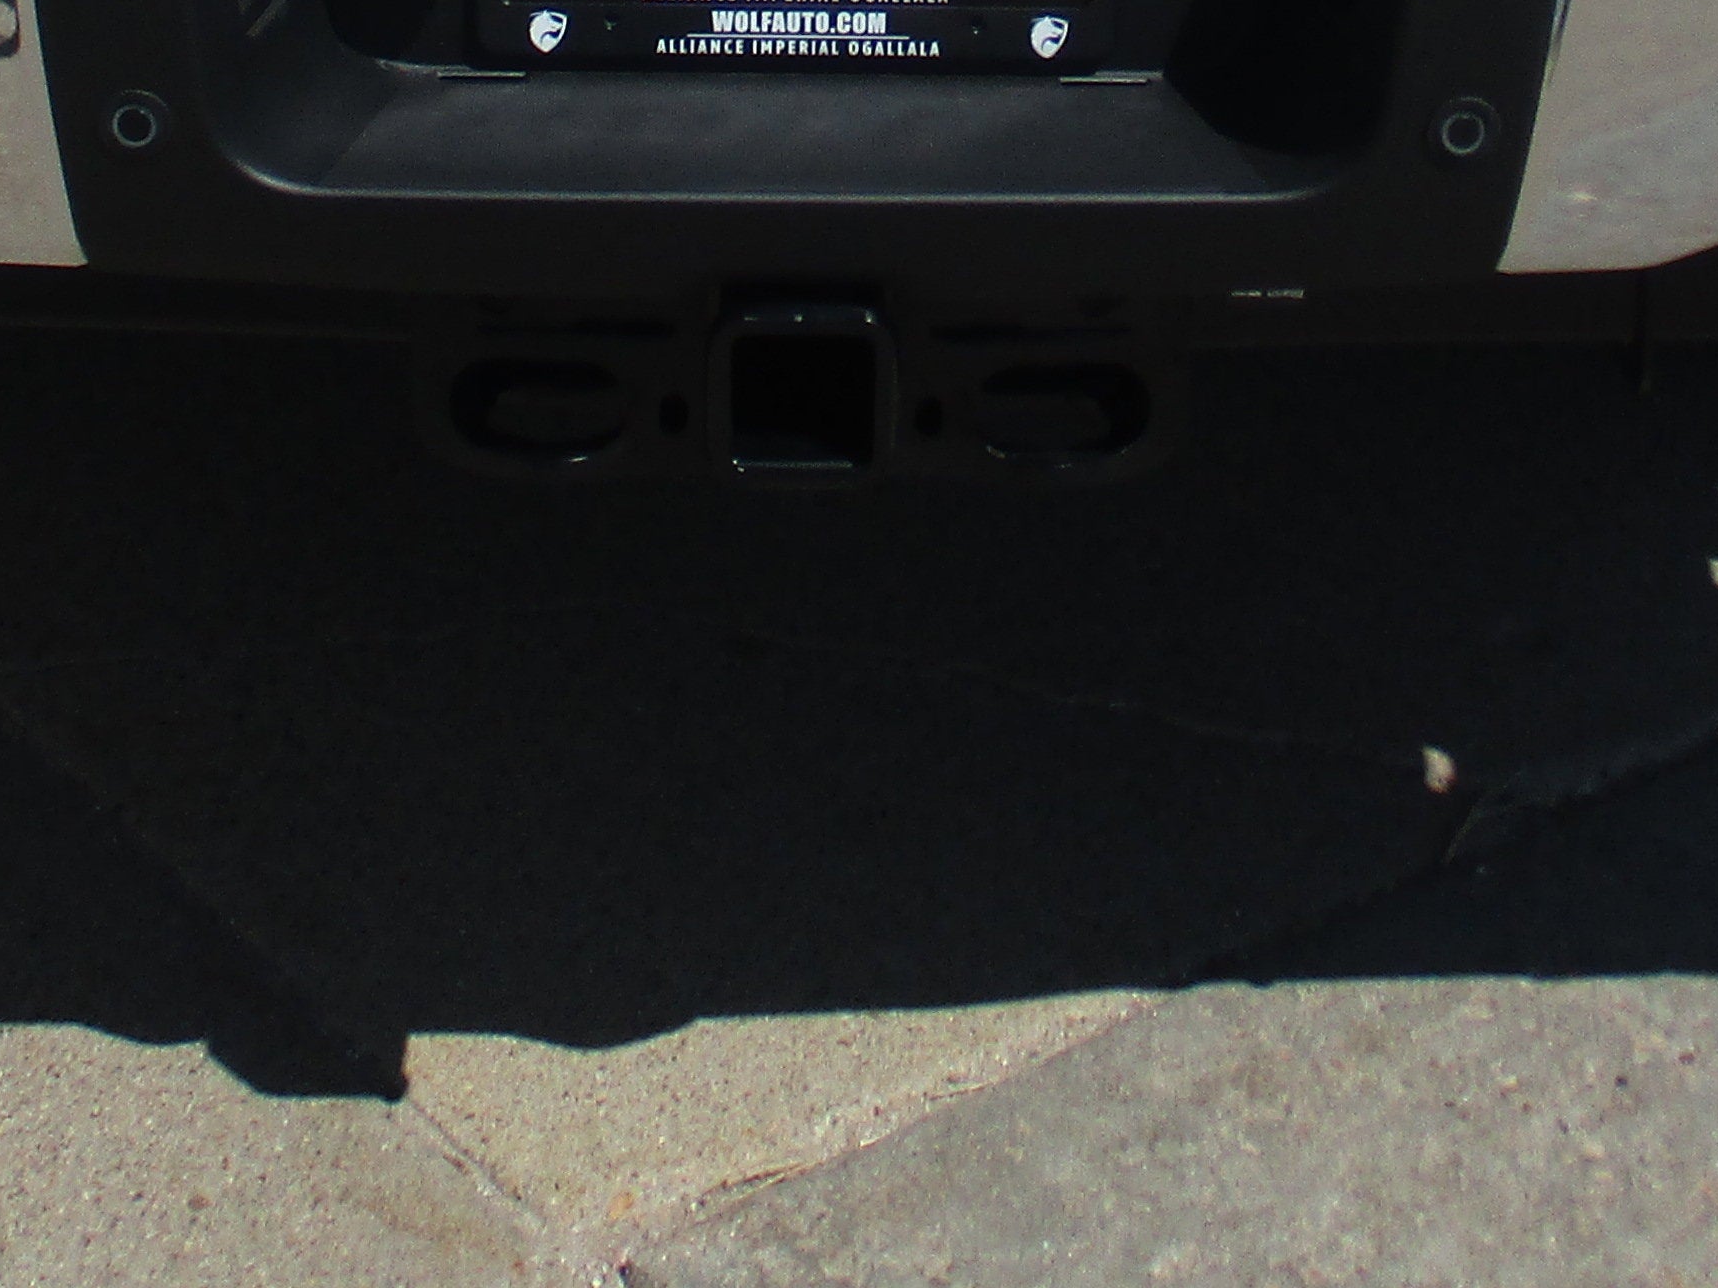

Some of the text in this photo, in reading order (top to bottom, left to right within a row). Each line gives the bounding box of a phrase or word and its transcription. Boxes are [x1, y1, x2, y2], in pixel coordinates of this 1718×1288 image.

[711, 10, 888, 34] WOLFAUTO.COM
[656, 38, 941, 57] ALLIANCE IMPERIAL OGALLALA
